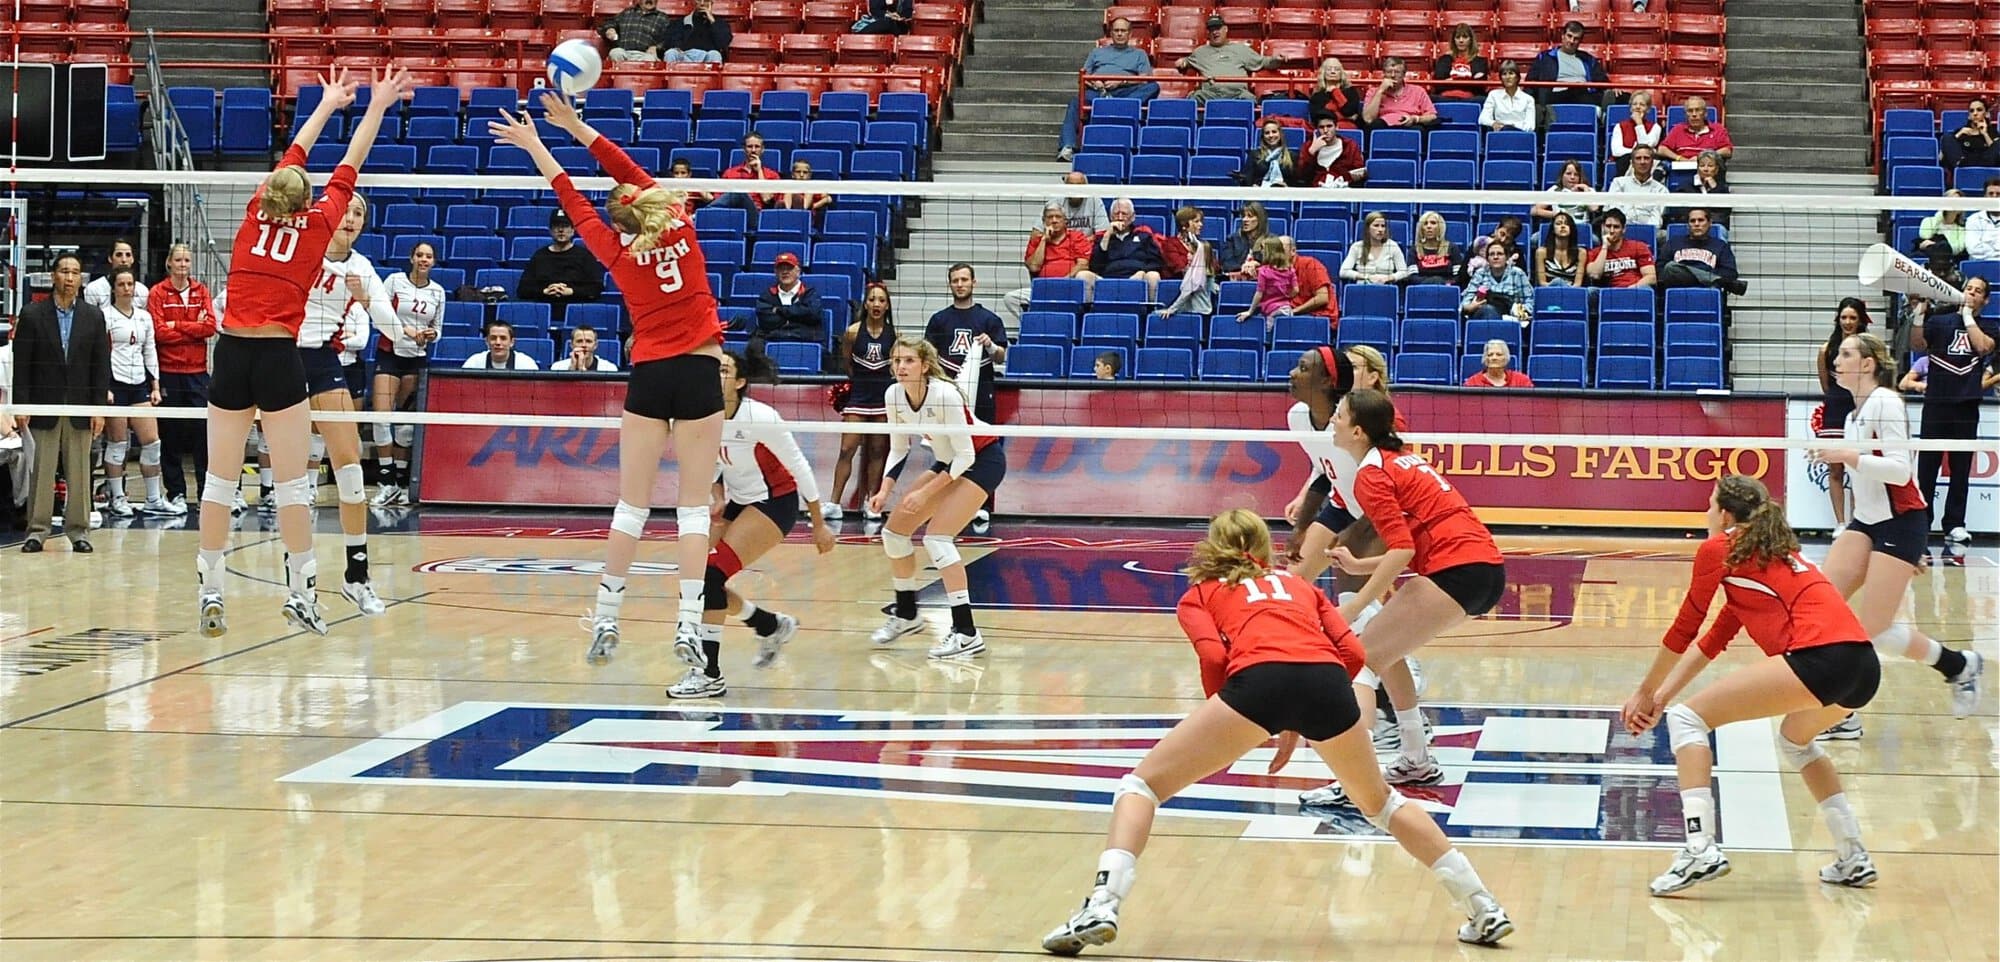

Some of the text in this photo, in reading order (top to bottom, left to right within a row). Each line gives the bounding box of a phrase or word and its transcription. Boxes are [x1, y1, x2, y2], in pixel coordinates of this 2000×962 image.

[250, 223, 299, 263] 10
[636, 237, 690, 266] UTAH
[313, 268, 336, 294] 14
[655, 260, 684, 294] 9
[1894, 257, 1952, 297] BEARDOWN
[411, 298, 428, 316] 22
[129, 330, 137, 346] 6
[1411, 441, 1771, 481] ELLS FARGO
[1240, 574, 1293, 604] 11
